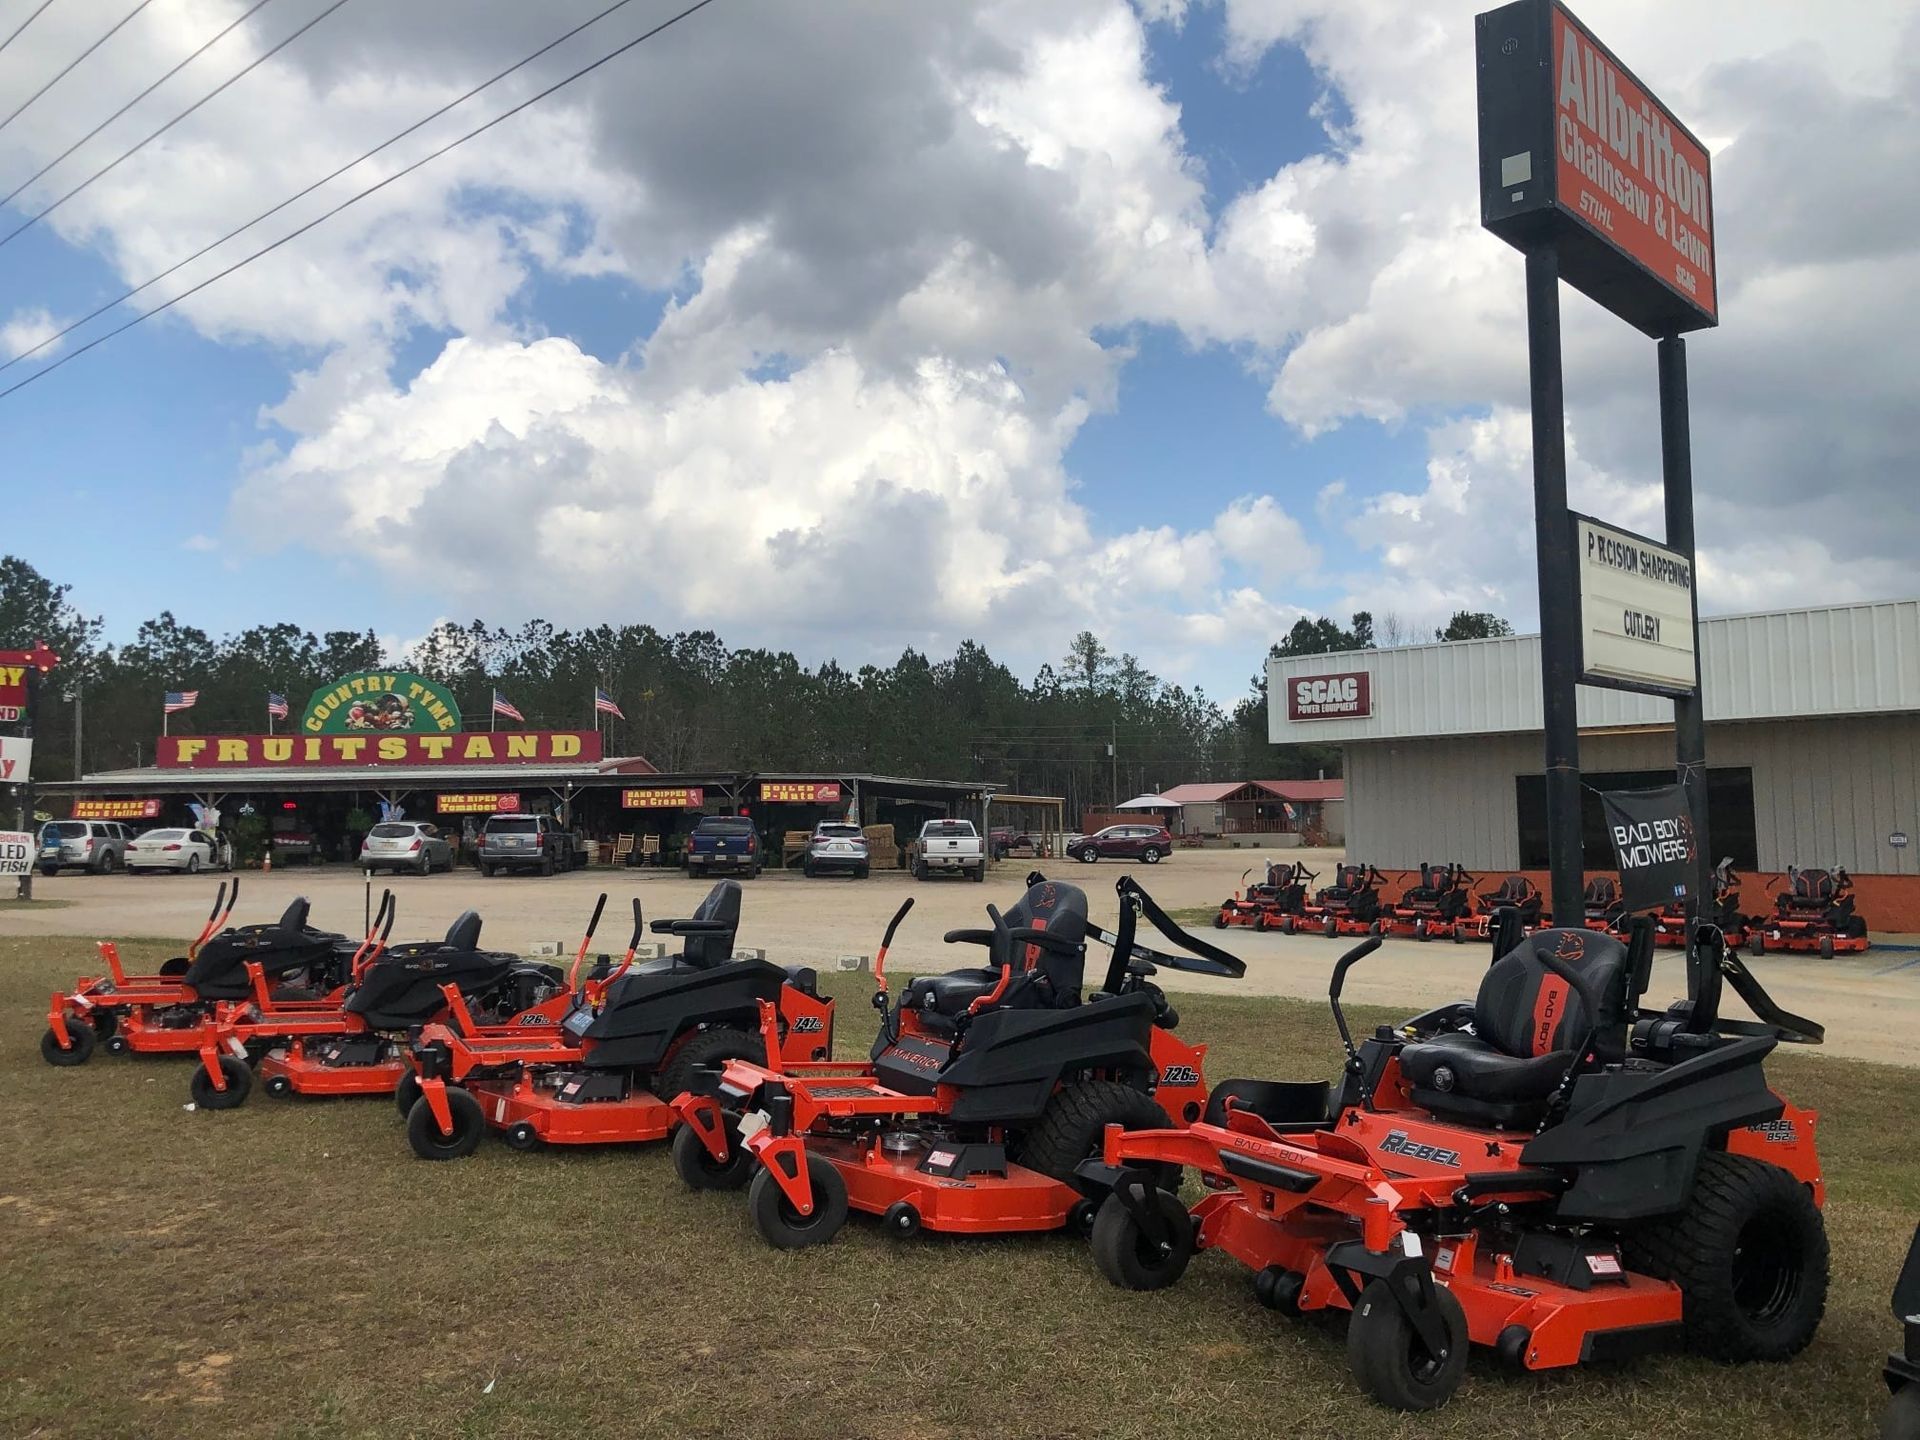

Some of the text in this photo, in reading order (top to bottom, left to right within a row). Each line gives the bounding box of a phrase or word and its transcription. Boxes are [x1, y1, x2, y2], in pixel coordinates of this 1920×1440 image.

[1559, 24, 1709, 233] Allbritton
[1559, 113, 1710, 276] Chainsaw & Lawn
[1579, 190, 1613, 231] STIHL
[1640, 551, 1690, 589] SHARPENING
[1623, 609, 1660, 642] CUTLERY
[305, 675, 456, 732] COUNTRY TYME
[1296, 678, 1358, 704] SCAG
[1298, 701, 1358, 714] POWER EQUIPMENT
[177, 735, 582, 762] FRUITSTAND
[440, 803, 497, 811] Tomatoes
[627, 797, 687, 806] Ice Cream
[762, 791, 814, 800] P-Nuts
[1613, 818, 1680, 846] BAD BOY
[1, 860, 28, 872] FISH
[1620, 838, 1687, 870] MOWERS
[1538, 990, 1558, 1051] BAD BOY
[891, 1048, 941, 1070] MAVERICK
[1161, 1065, 1199, 1082] 726cc
[1234, 1137, 1309, 1165] BAD BOY
[1378, 1129, 1462, 1168] REBEL
